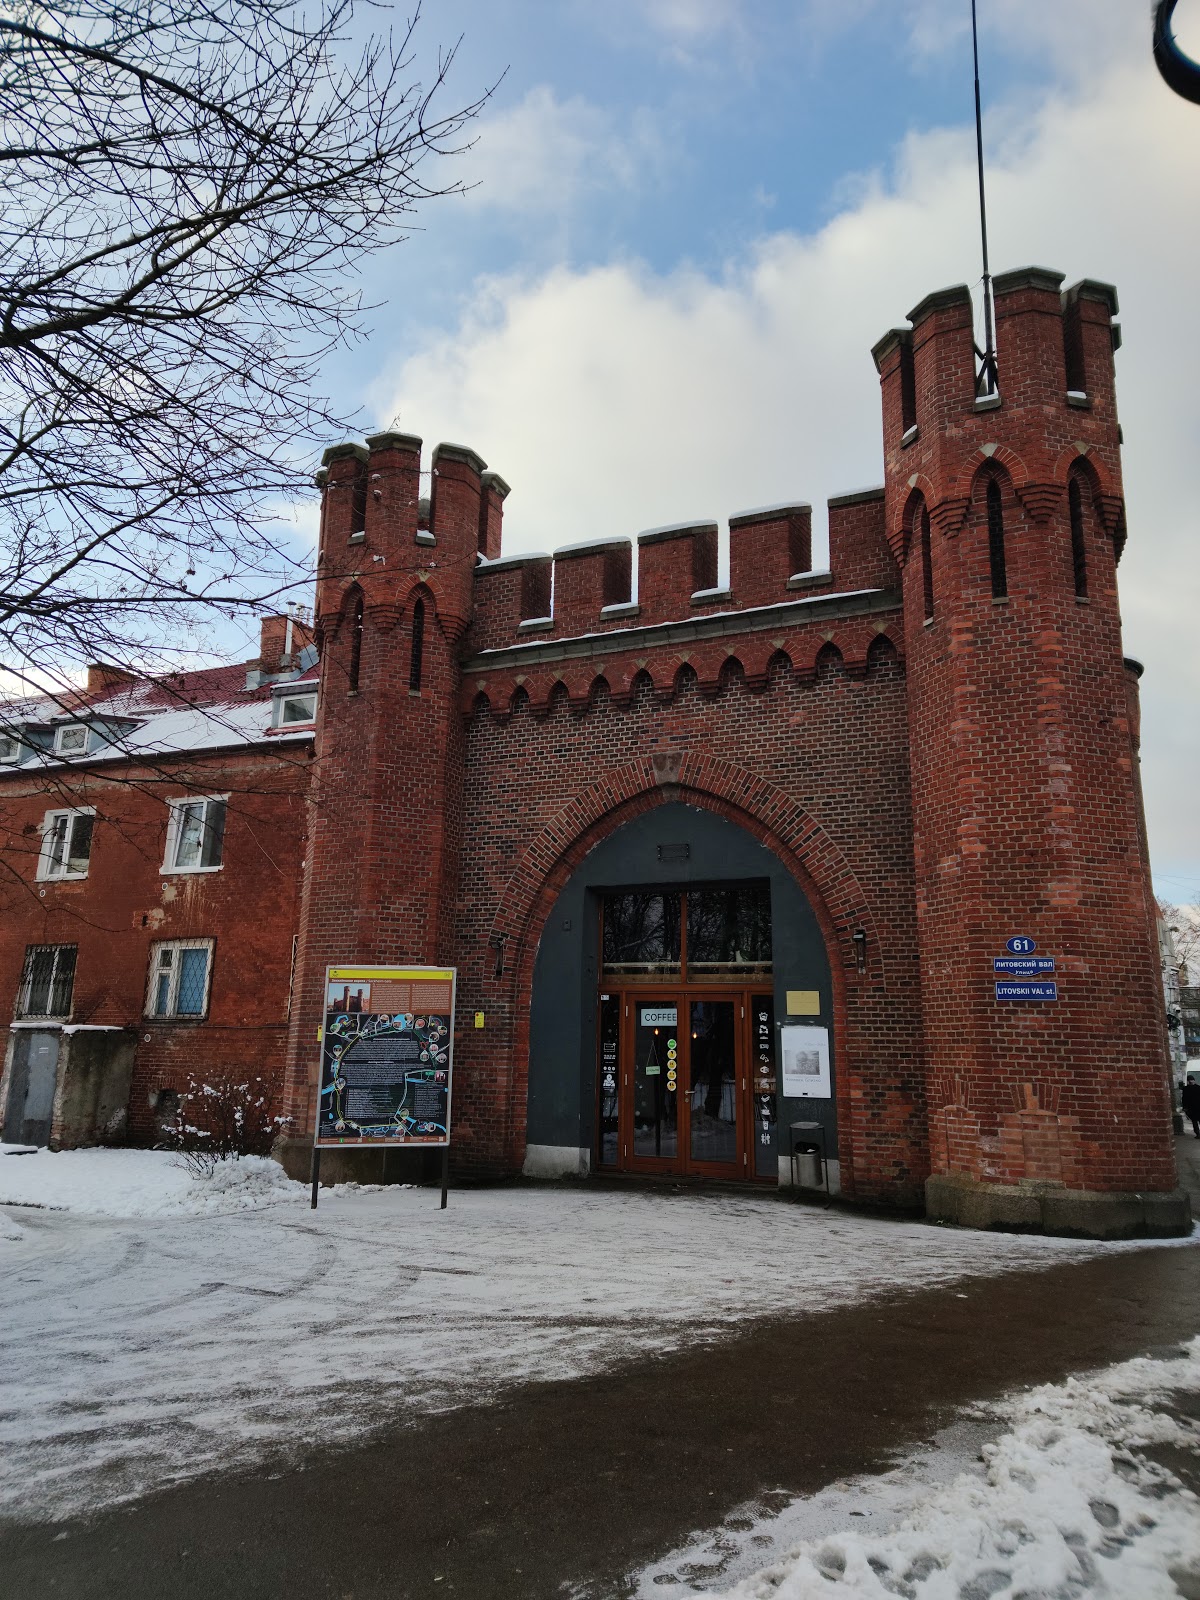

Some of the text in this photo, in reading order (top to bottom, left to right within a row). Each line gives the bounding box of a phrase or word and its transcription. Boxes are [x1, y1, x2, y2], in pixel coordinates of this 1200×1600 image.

[1013, 939, 1029, 951] 61
[997, 987, 1030, 995] LITOVSKII
[1031, 987, 1045, 995] VAL
[644, 1013, 677, 1022] COFFEE
